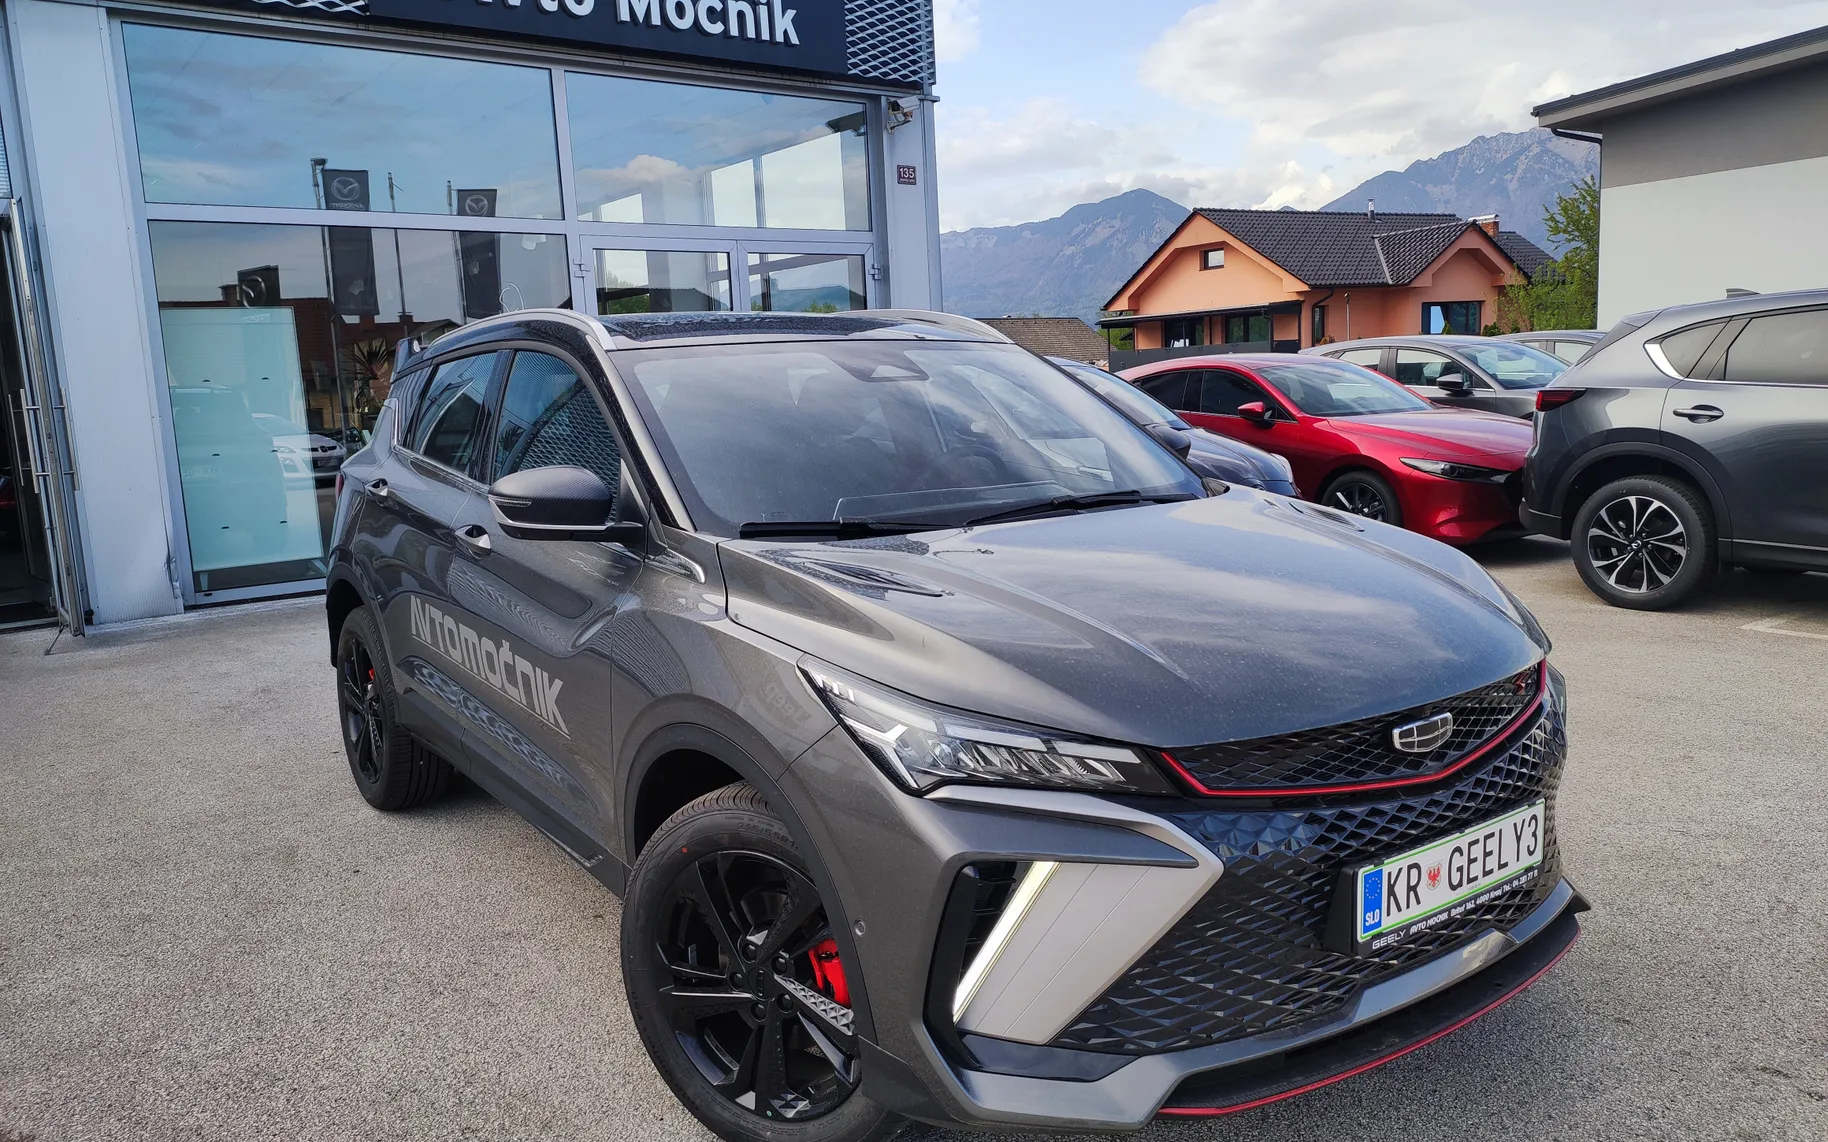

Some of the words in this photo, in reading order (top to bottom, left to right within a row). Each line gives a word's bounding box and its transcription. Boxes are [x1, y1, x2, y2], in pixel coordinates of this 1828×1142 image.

[899, 168, 915, 179] 135
[737, 821, 800, 851] 215/55R1
[1386, 862, 1422, 917] KR
[1365, 908, 1380, 927] SLO
[1372, 929, 1406, 949] GEELY
[1410, 921, 1426, 935] AVTO
